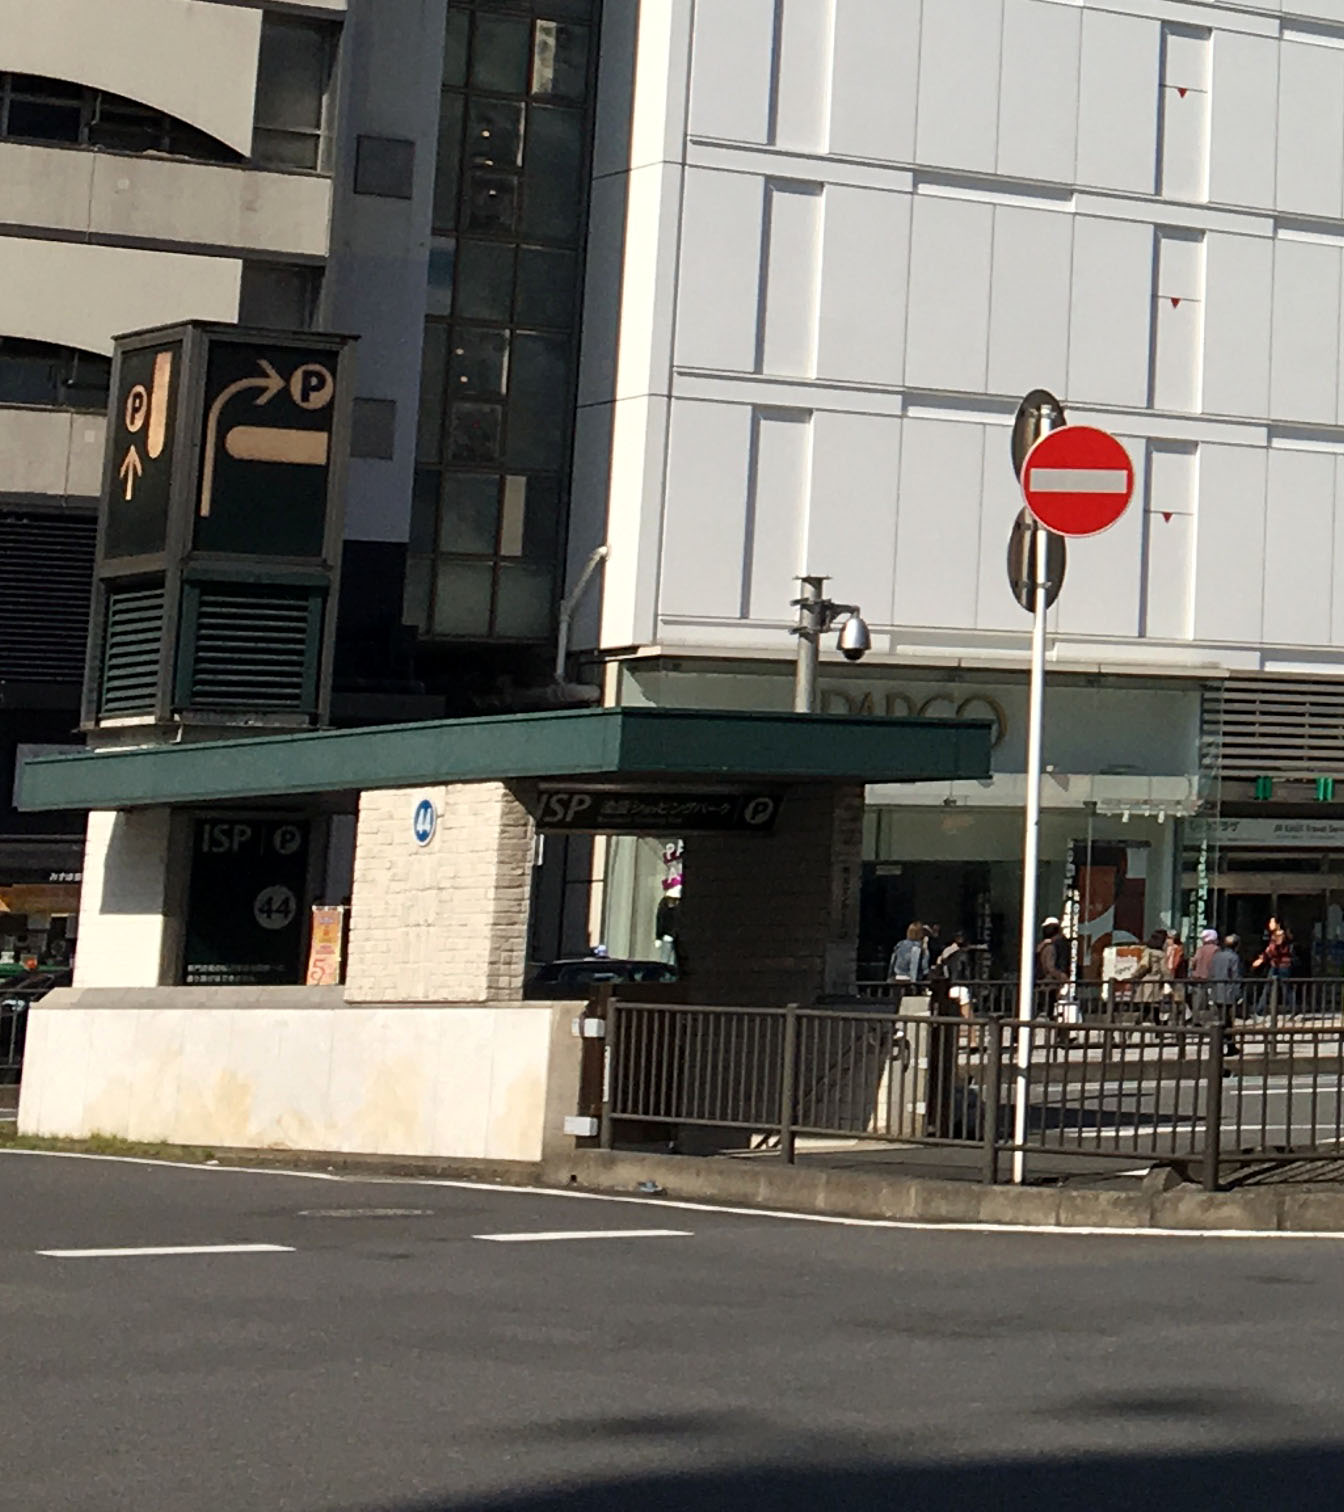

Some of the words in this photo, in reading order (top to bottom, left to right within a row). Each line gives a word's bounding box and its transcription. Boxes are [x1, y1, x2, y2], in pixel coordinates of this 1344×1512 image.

[536, 794, 592, 822] ISP
[201, 824, 252, 854] ISP
[257, 895, 292, 920] 44
